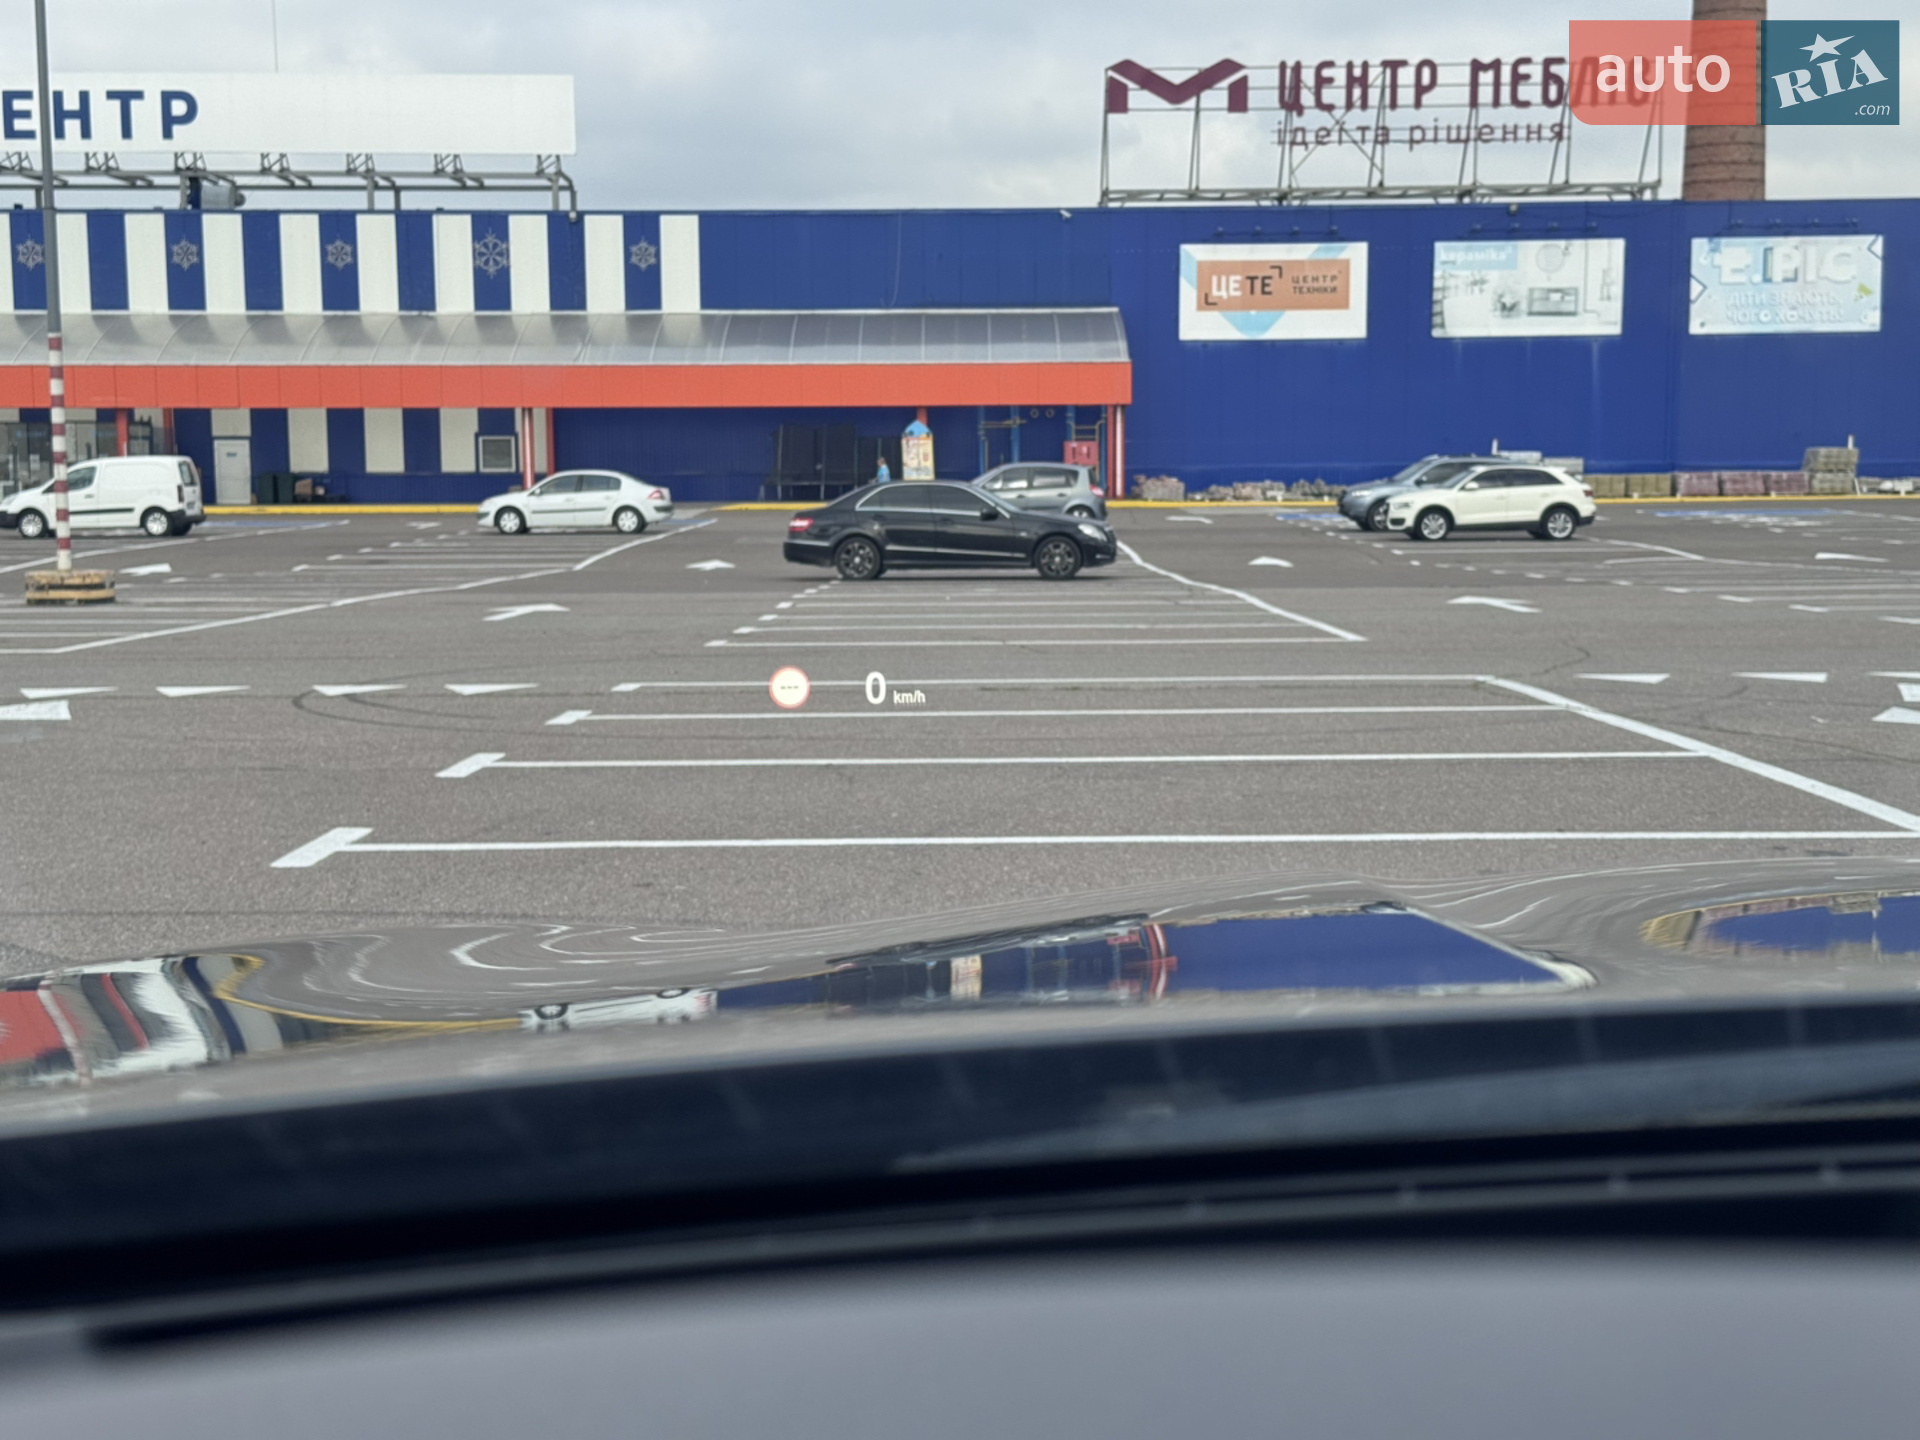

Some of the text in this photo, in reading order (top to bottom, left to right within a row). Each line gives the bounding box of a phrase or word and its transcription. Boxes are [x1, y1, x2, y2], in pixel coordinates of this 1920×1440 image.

[1278, 58, 1438, 117] ЦЕНТР
[1356, 125, 1390, 145] та
[1408, 117, 1565, 151] рішення
[1291, 274, 1338, 285] ЦЕНТР
[1292, 285, 1338, 295] ТЕХНІКИ
[865, 671, 926, 705] 0 km/h
